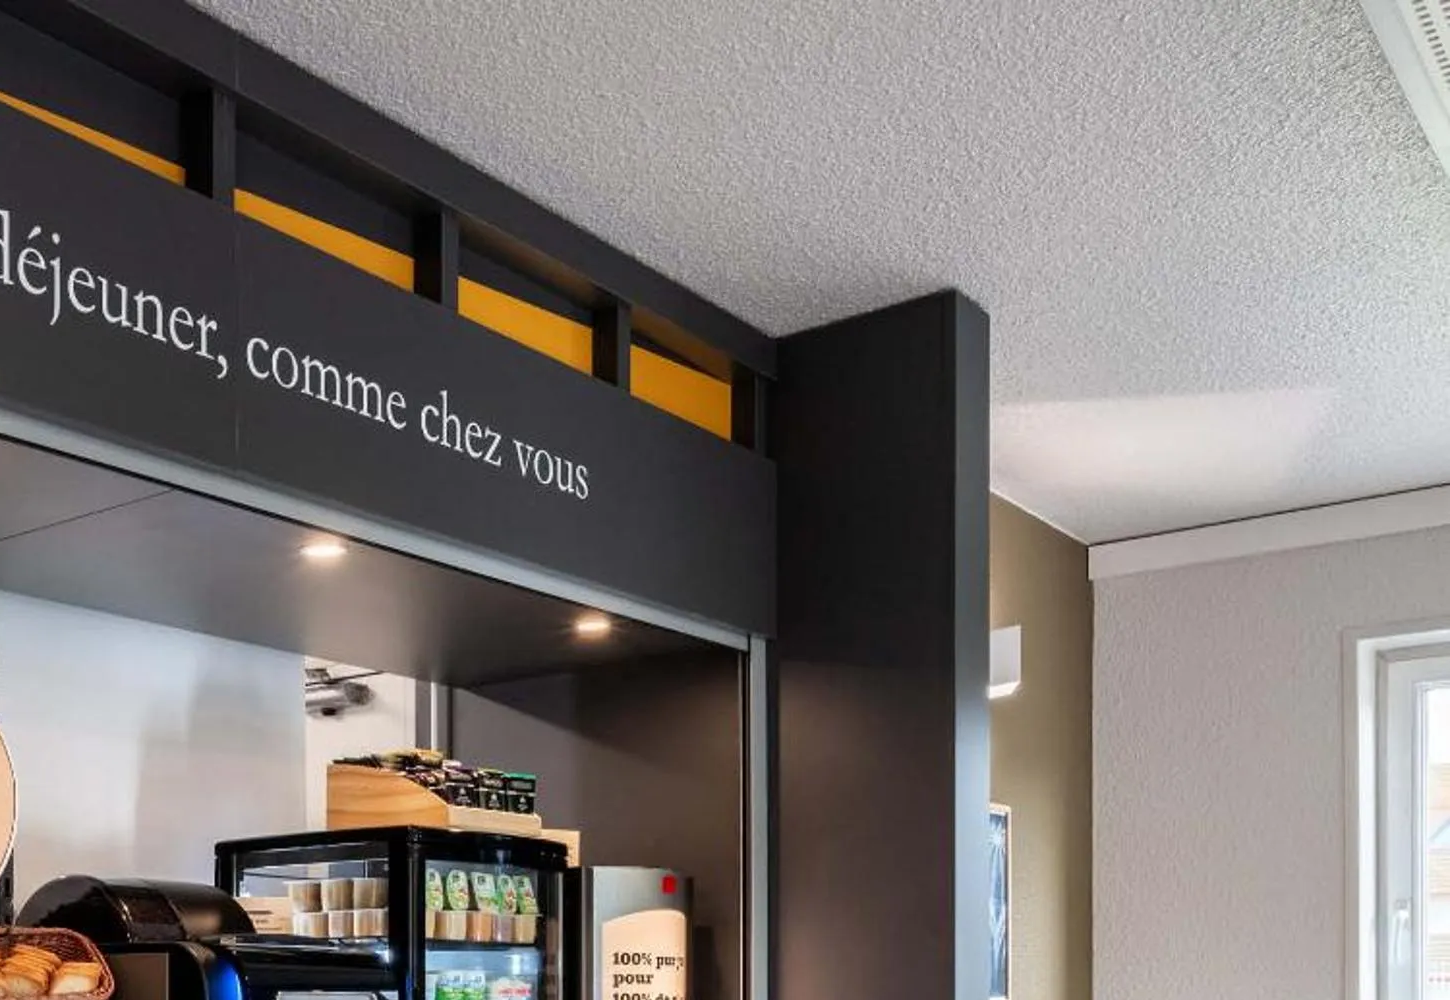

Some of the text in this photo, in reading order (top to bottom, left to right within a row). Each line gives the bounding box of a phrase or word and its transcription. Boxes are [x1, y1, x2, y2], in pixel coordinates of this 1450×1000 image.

[246, 336, 408, 431] comme
[420, 390, 503, 464] chez
[514, 440, 591, 501] vous
[612, 952, 652, 966] 100%
[612, 973, 654, 988] pour
